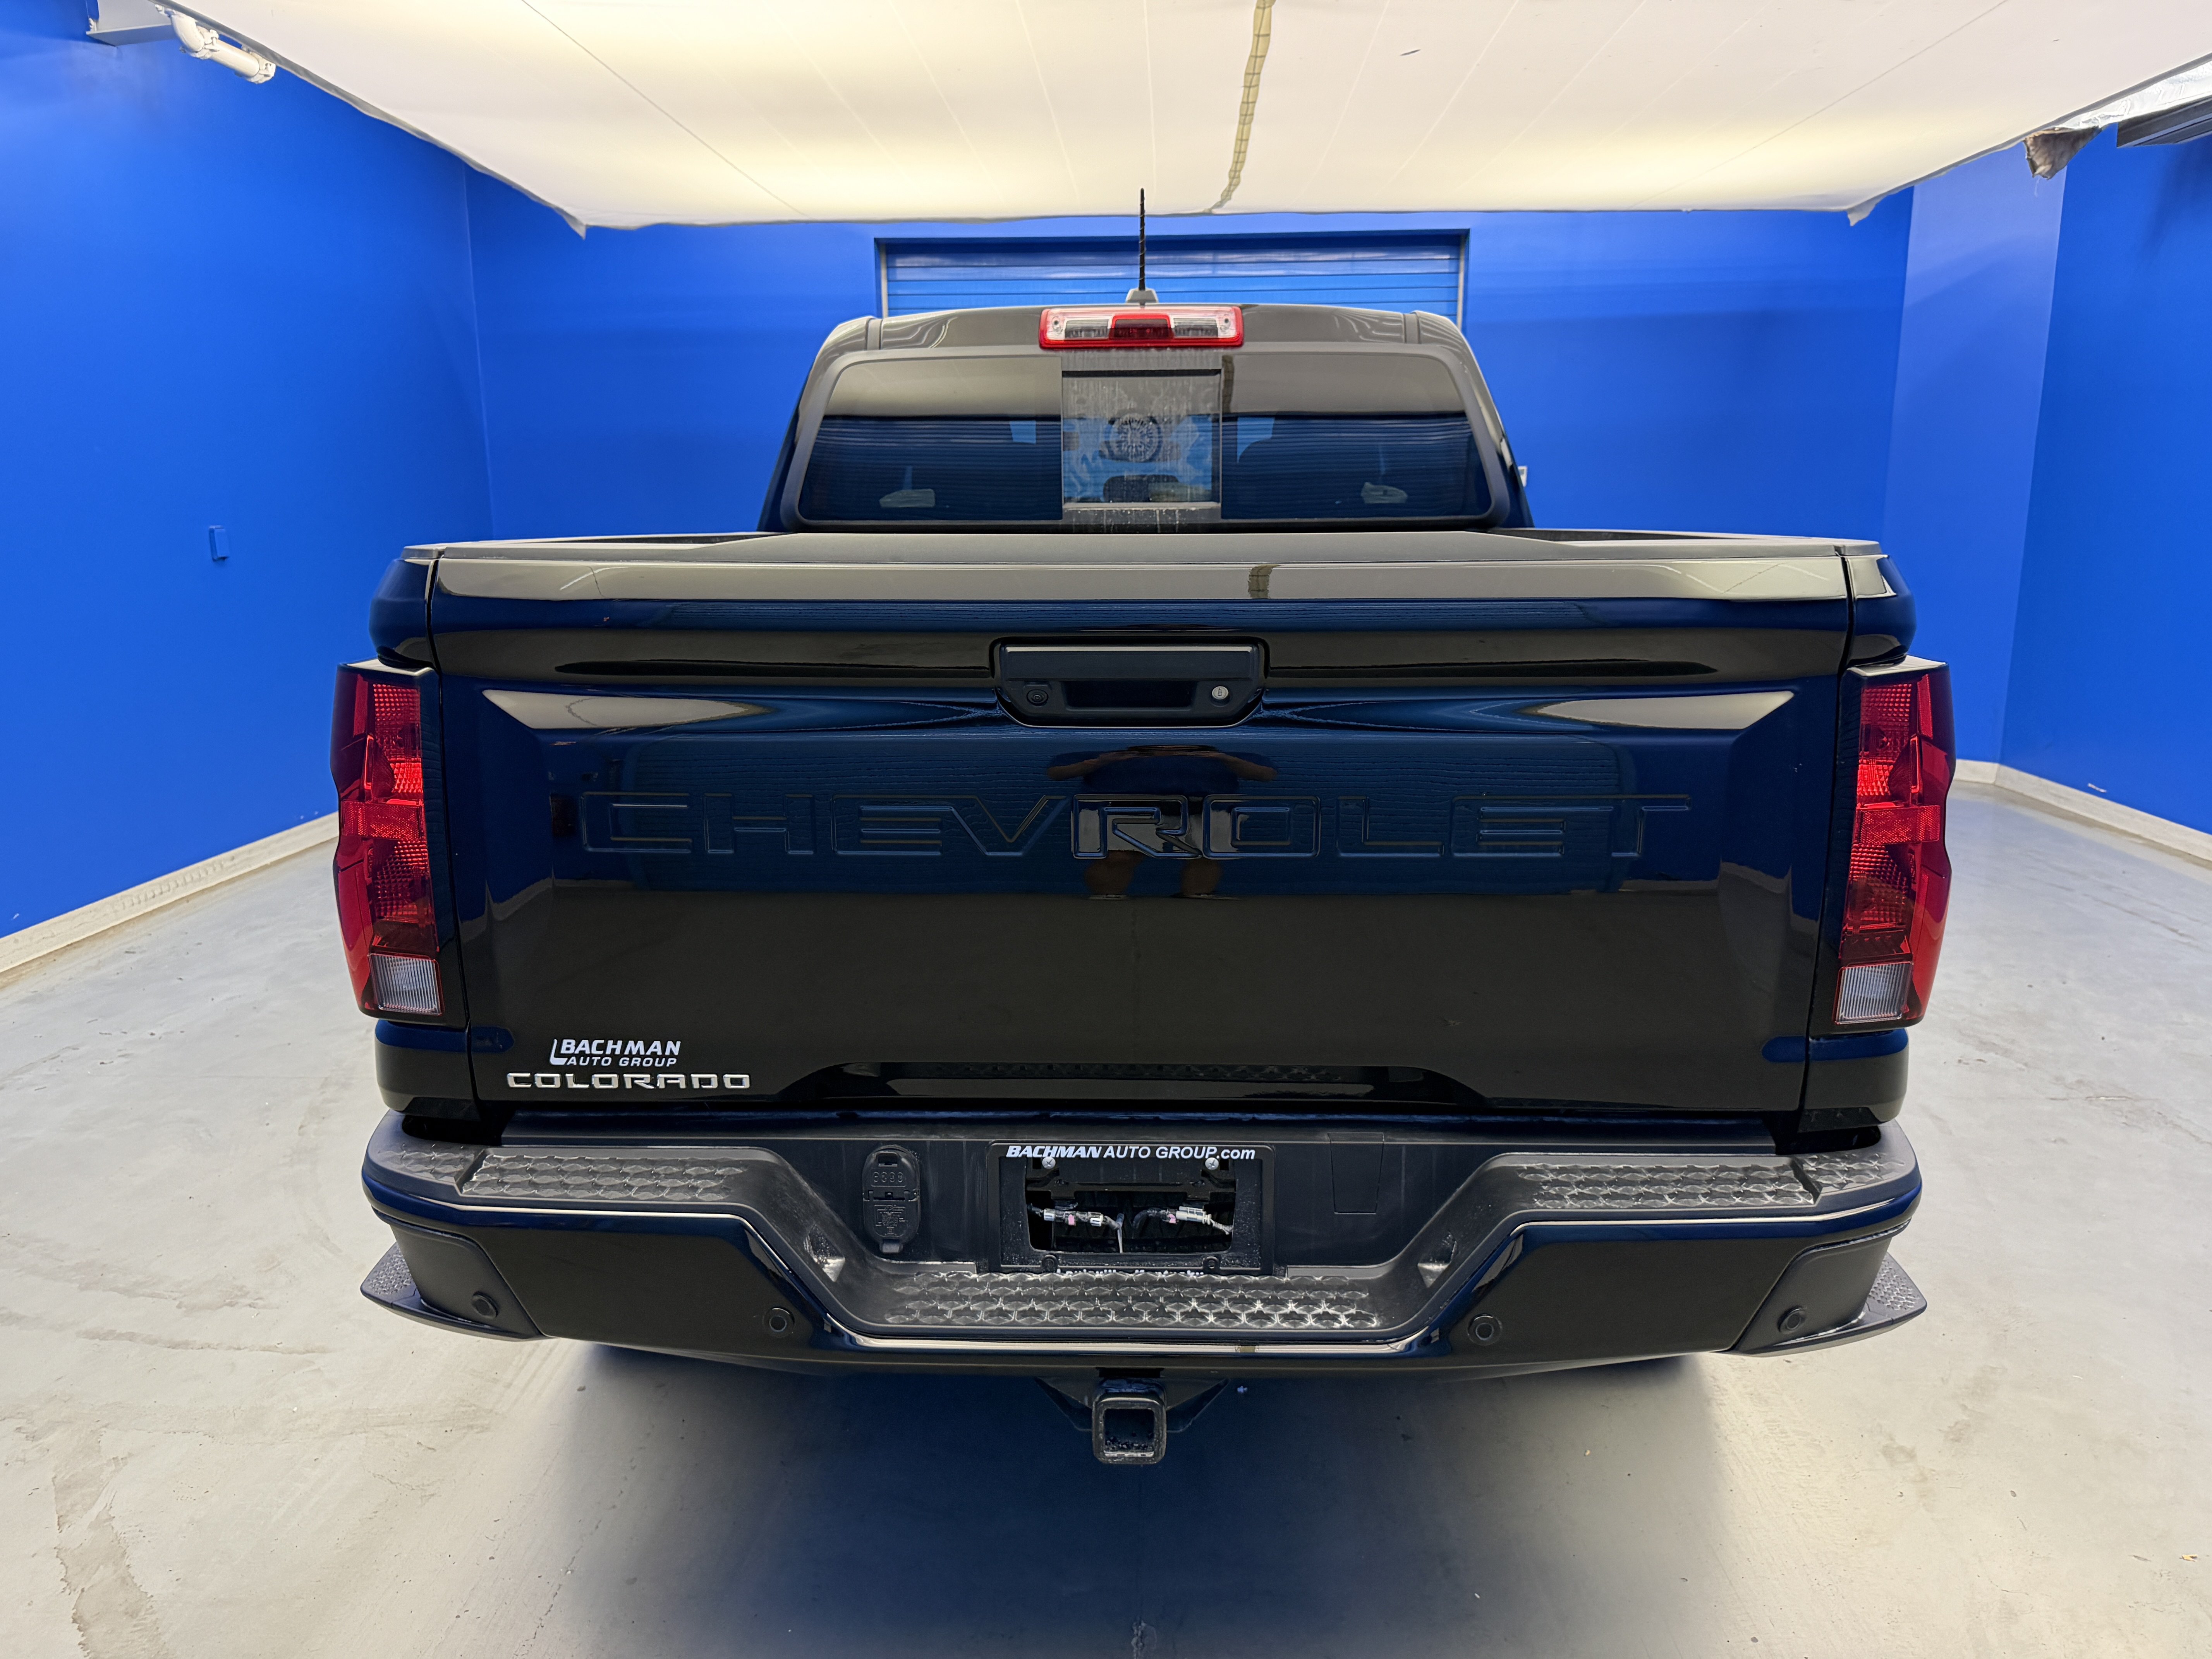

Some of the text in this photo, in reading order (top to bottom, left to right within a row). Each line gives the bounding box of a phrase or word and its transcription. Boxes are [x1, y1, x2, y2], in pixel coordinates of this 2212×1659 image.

[580, 792, 1691, 859] CHEVROLET
[560, 1039, 681, 1056] BACHMAN
[567, 1056, 677, 1067] AUTO GROUP
[507, 1072, 750, 1089] COLORADO
[1006, 1146, 1256, 1160] BACHMAN AUTO GROUP.com
